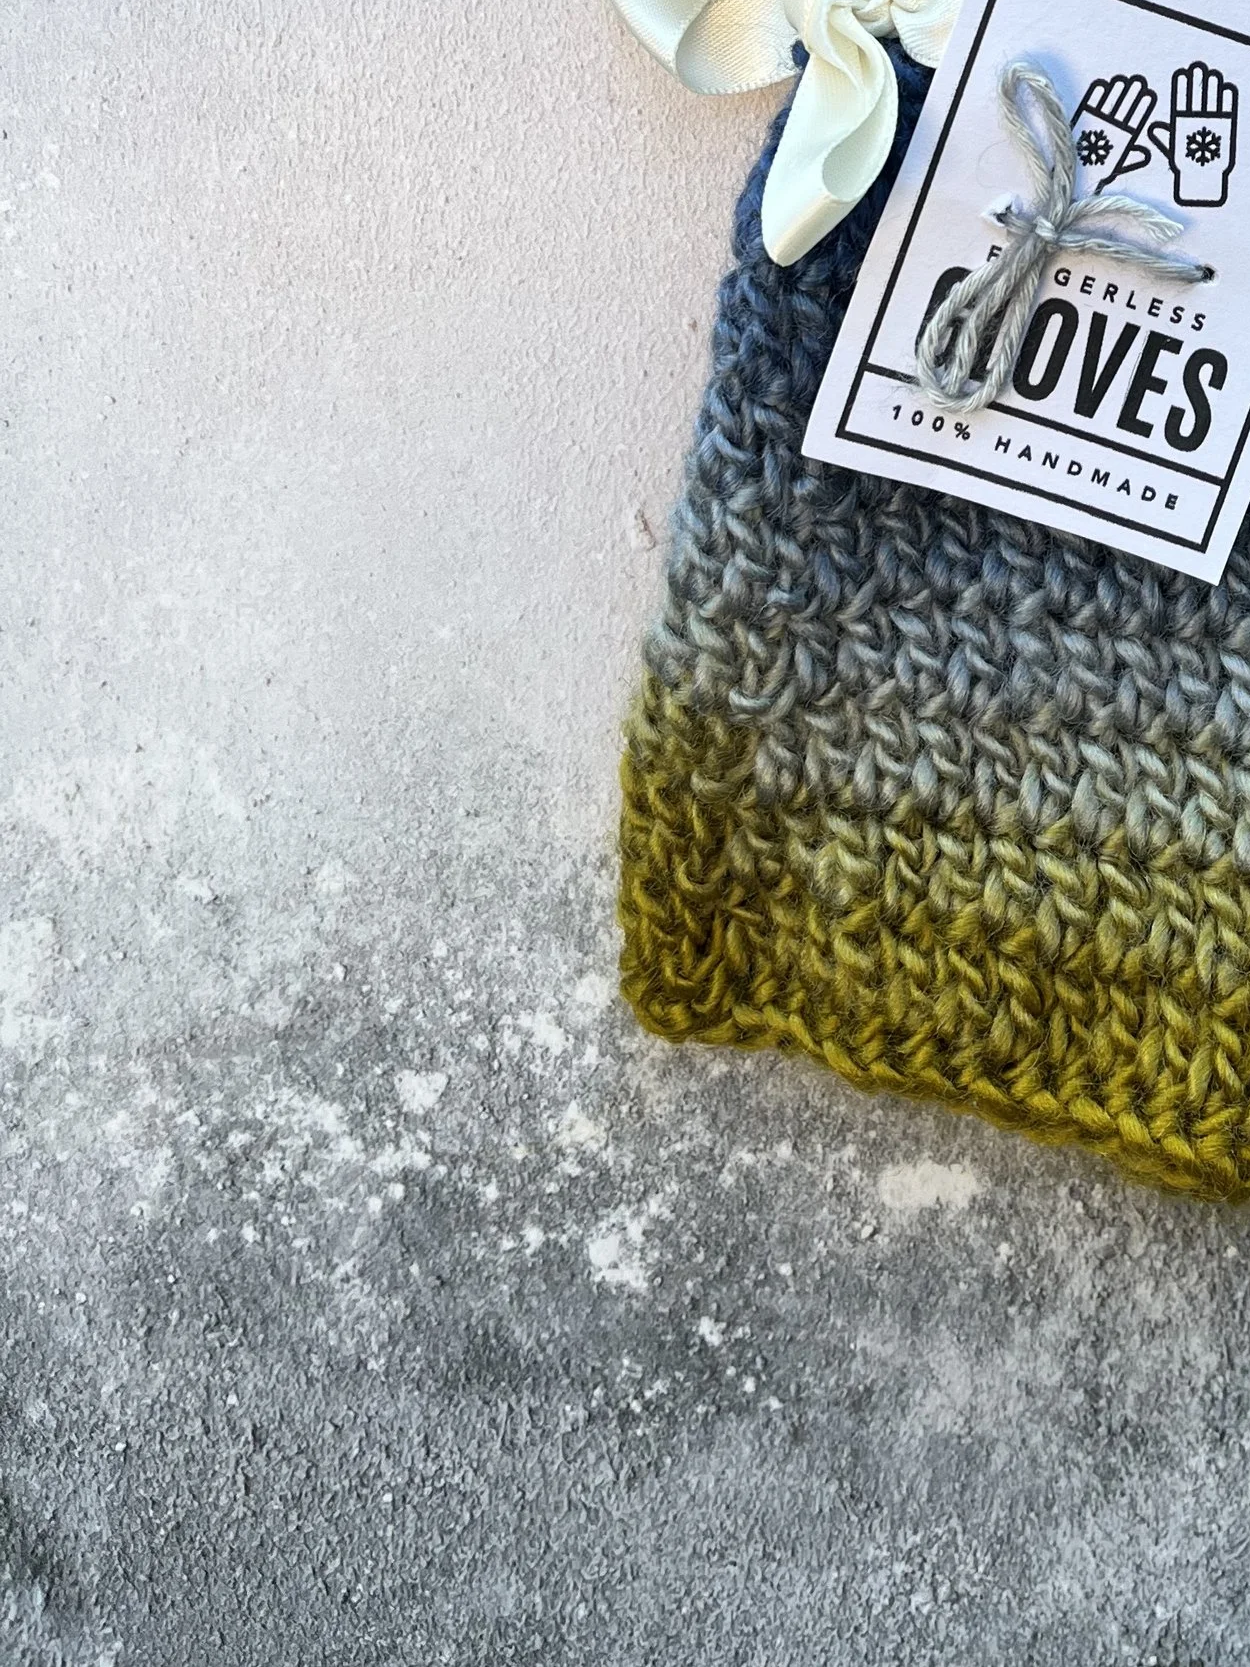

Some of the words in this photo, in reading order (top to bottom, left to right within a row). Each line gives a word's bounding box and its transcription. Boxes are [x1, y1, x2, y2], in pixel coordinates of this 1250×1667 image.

[986, 244, 1206, 331] FGERLESS
[892, 405, 972, 441] 100%
[995, 436, 1179, 510] HANDMADE
